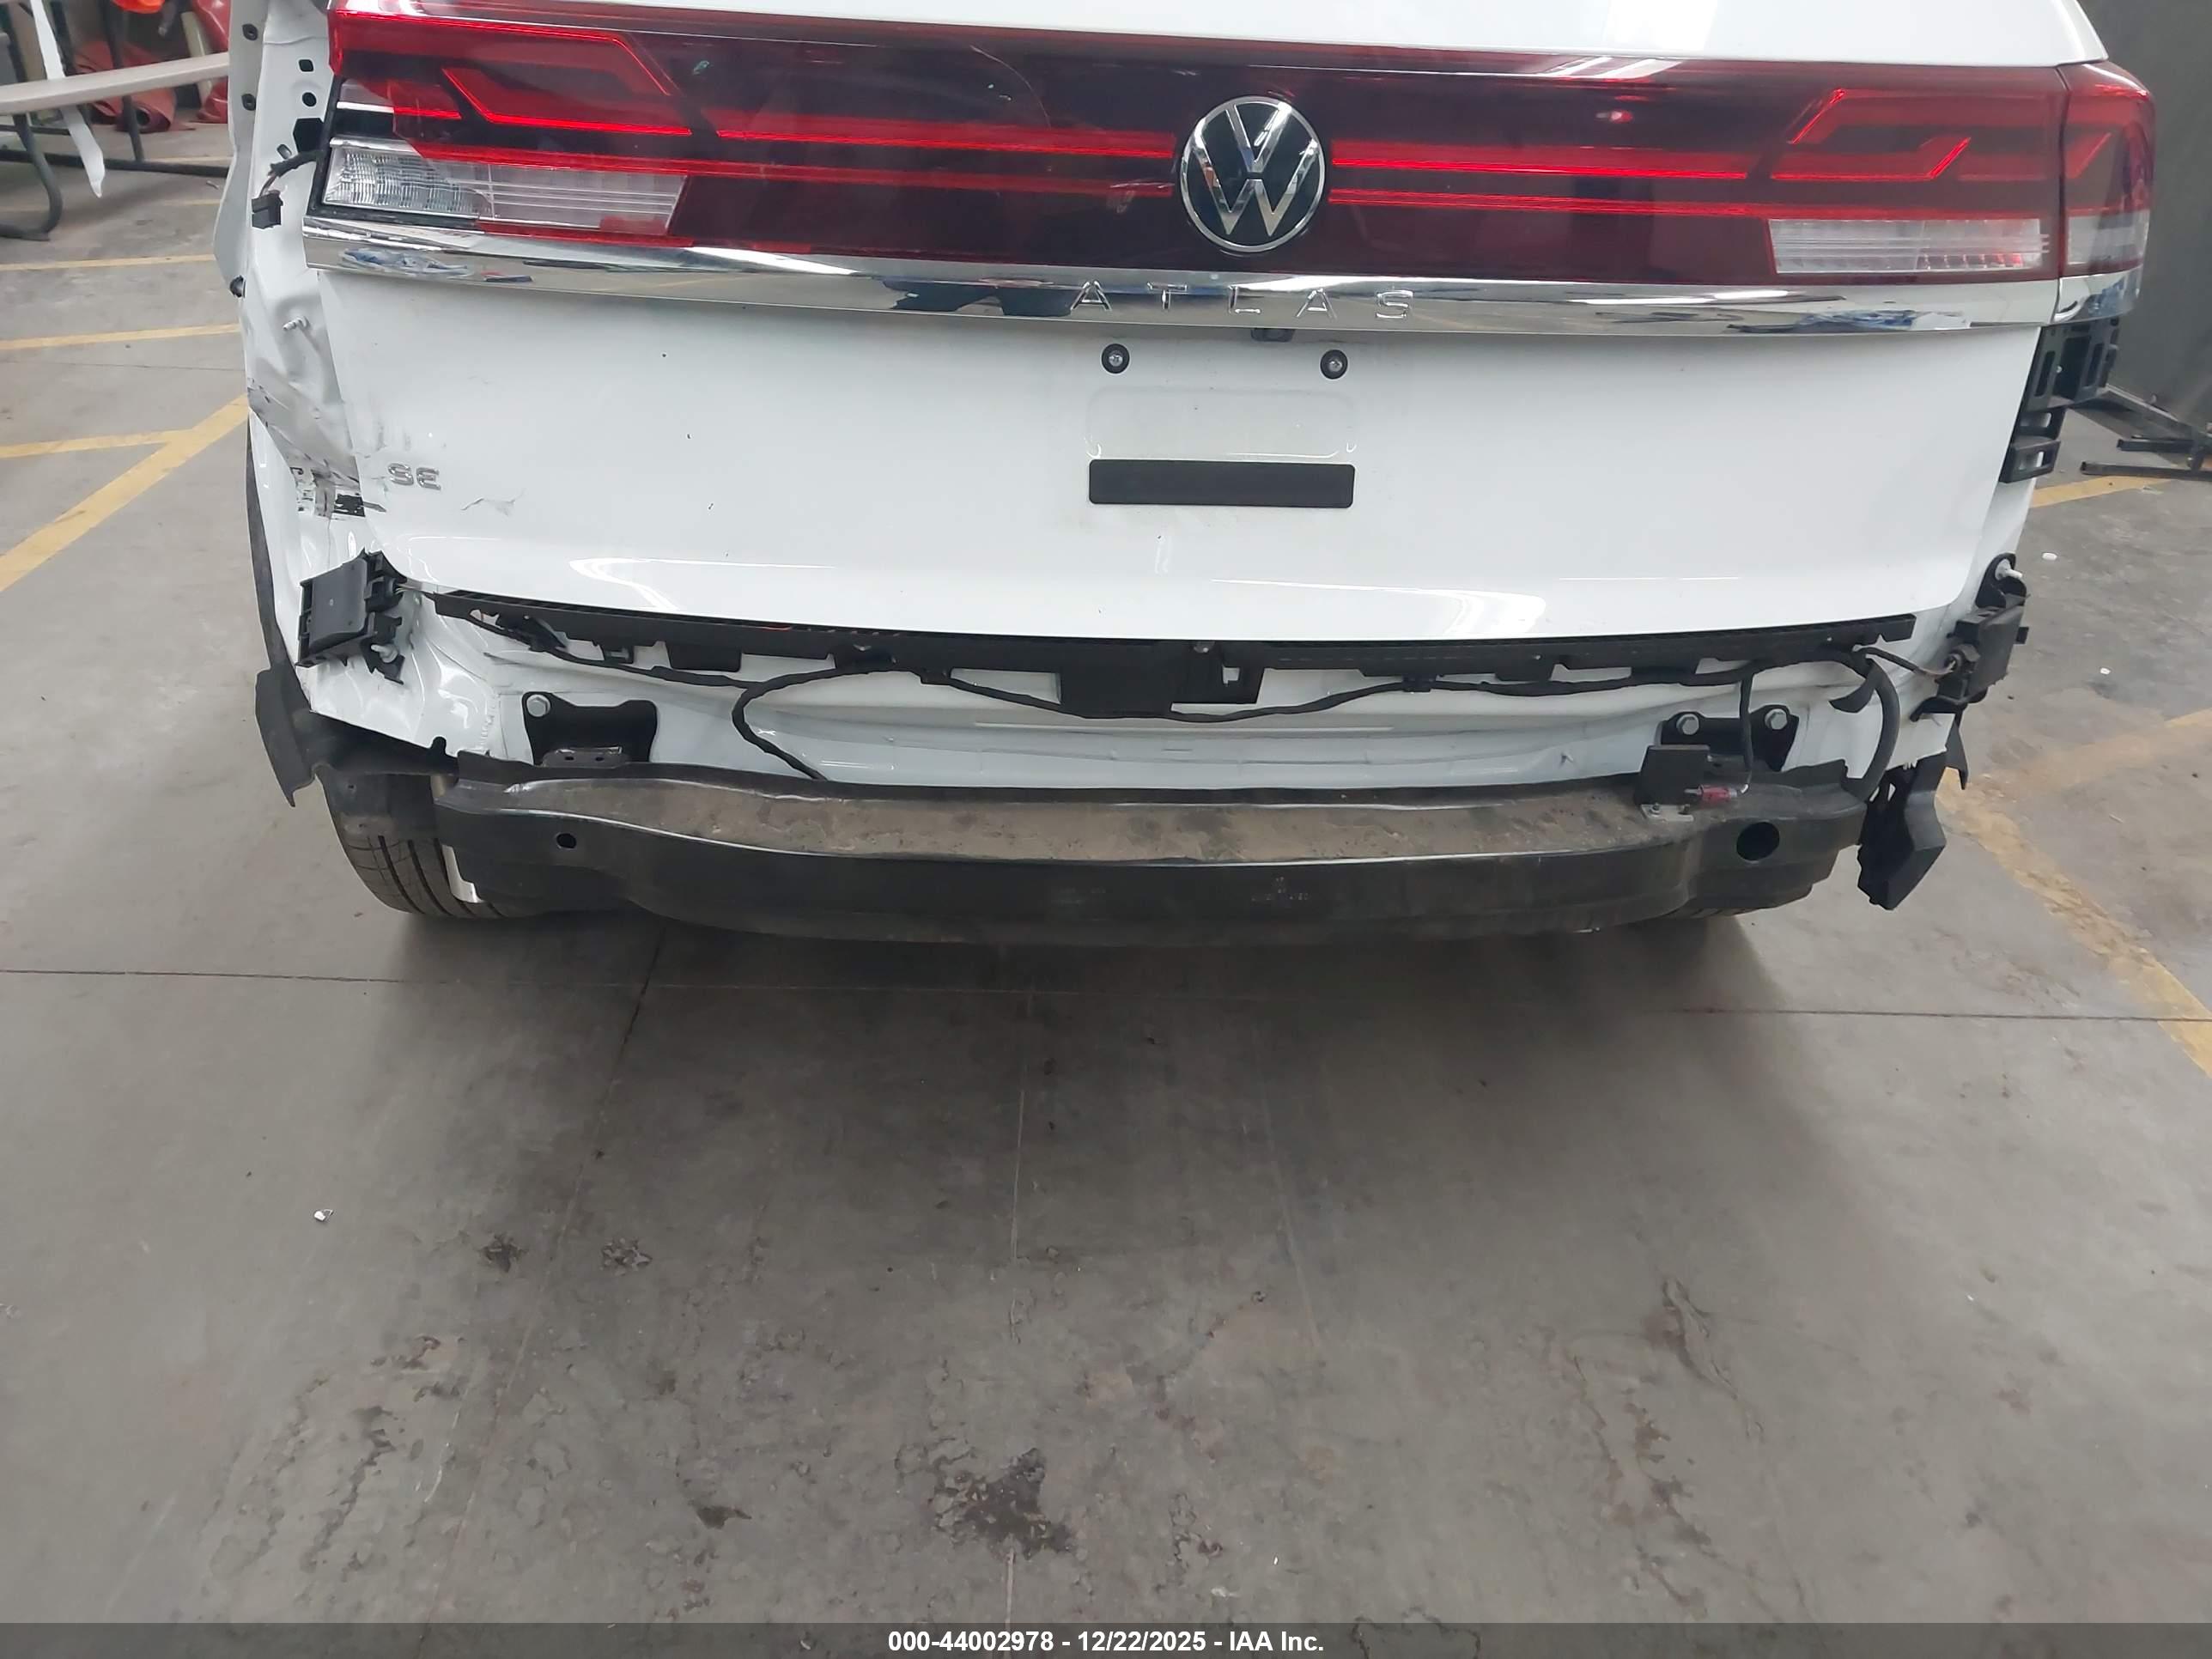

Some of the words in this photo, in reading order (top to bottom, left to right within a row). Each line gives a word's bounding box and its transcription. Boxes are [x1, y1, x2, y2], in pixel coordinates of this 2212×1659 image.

[1190, 100, 1321, 239] VW
[1070, 278, 1414, 320] ATLAS
[387, 462, 441, 490] SE
